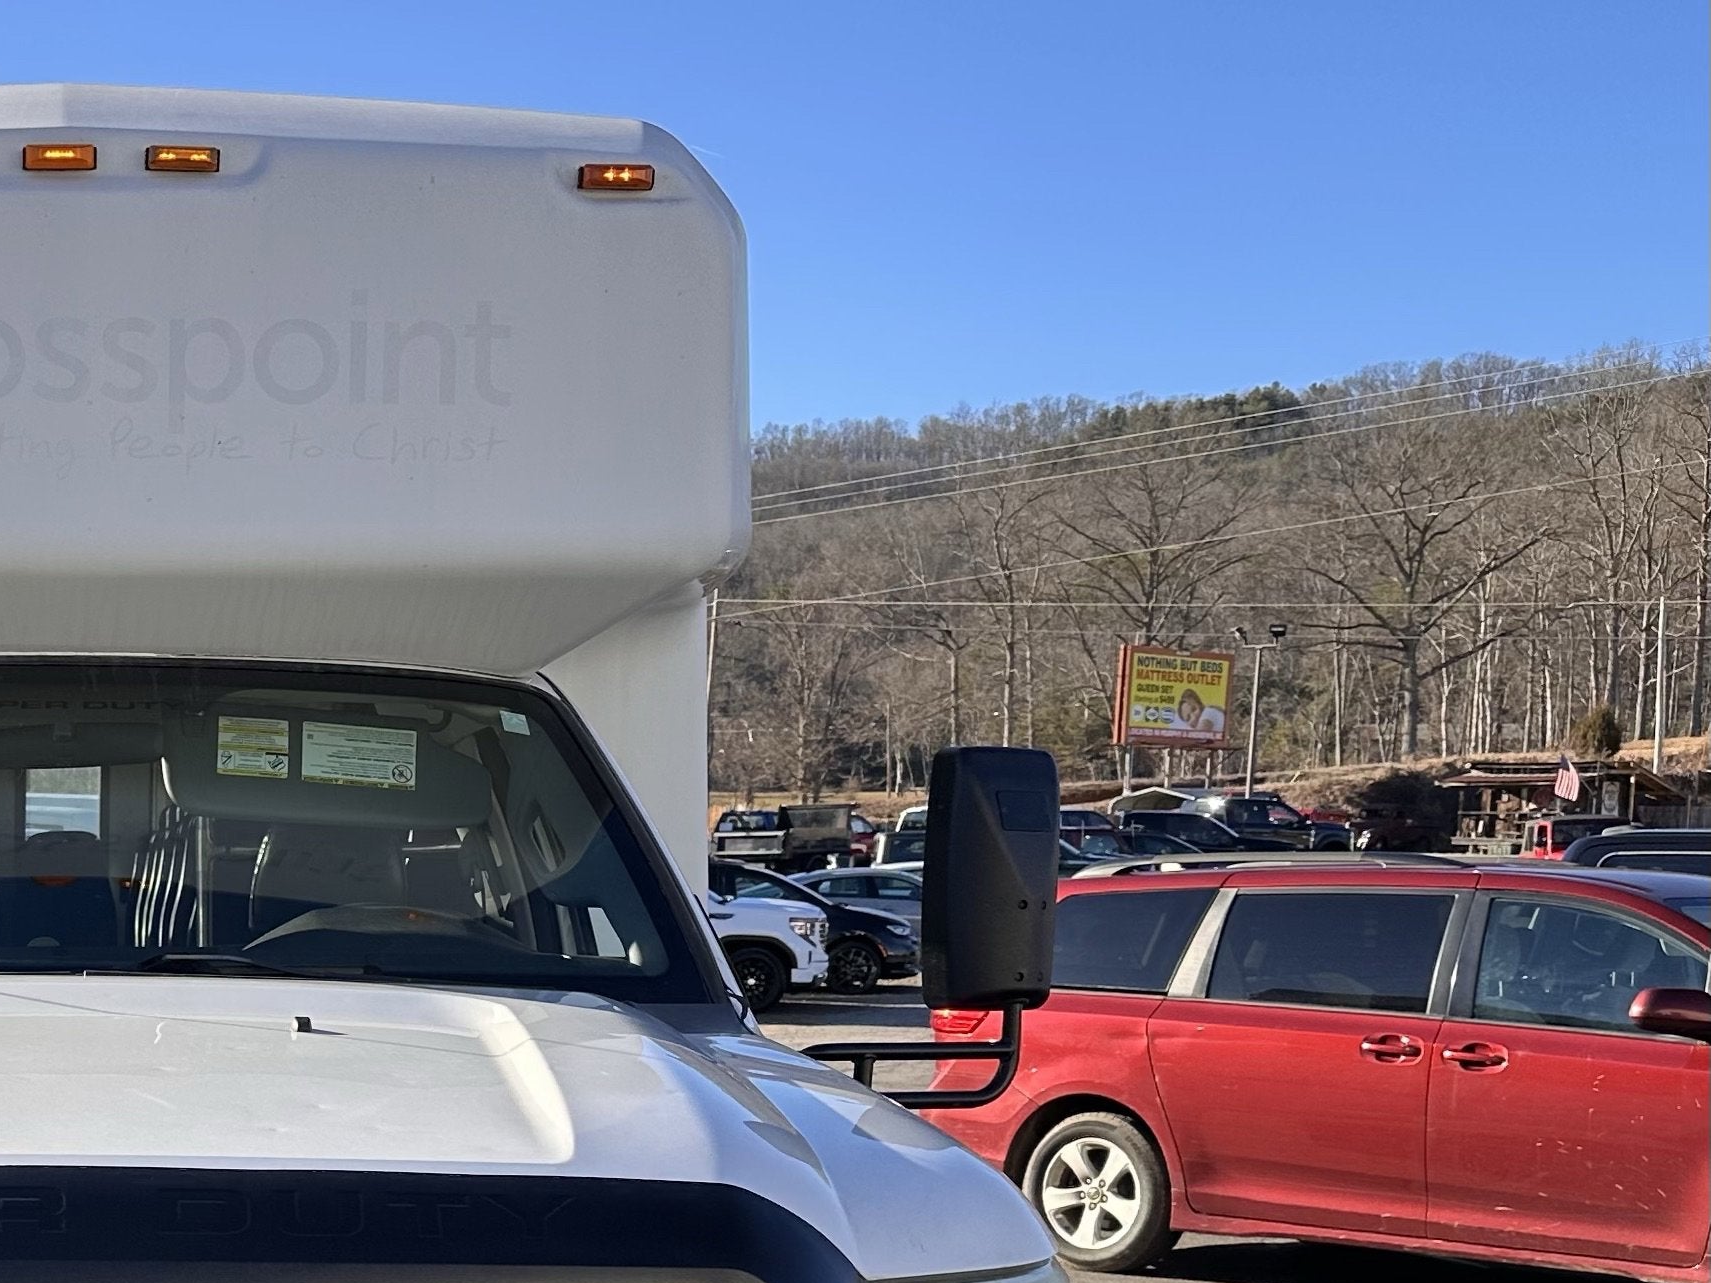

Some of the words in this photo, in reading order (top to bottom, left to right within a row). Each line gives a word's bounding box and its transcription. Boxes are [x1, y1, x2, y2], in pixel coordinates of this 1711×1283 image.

[107, 415, 254, 472] People
[279, 422, 327, 462] to
[351, 421, 510, 465] Christ
[1136, 669, 1184, 683] MATTRESS
[1187, 673, 1222, 686] OUTLET
[1137, 656, 1178, 670] NOTHING
[1180, 660, 1198, 671] BUT
[1201, 661, 1223, 673] BEDS
[156, 1188, 578, 1239] DUTY
